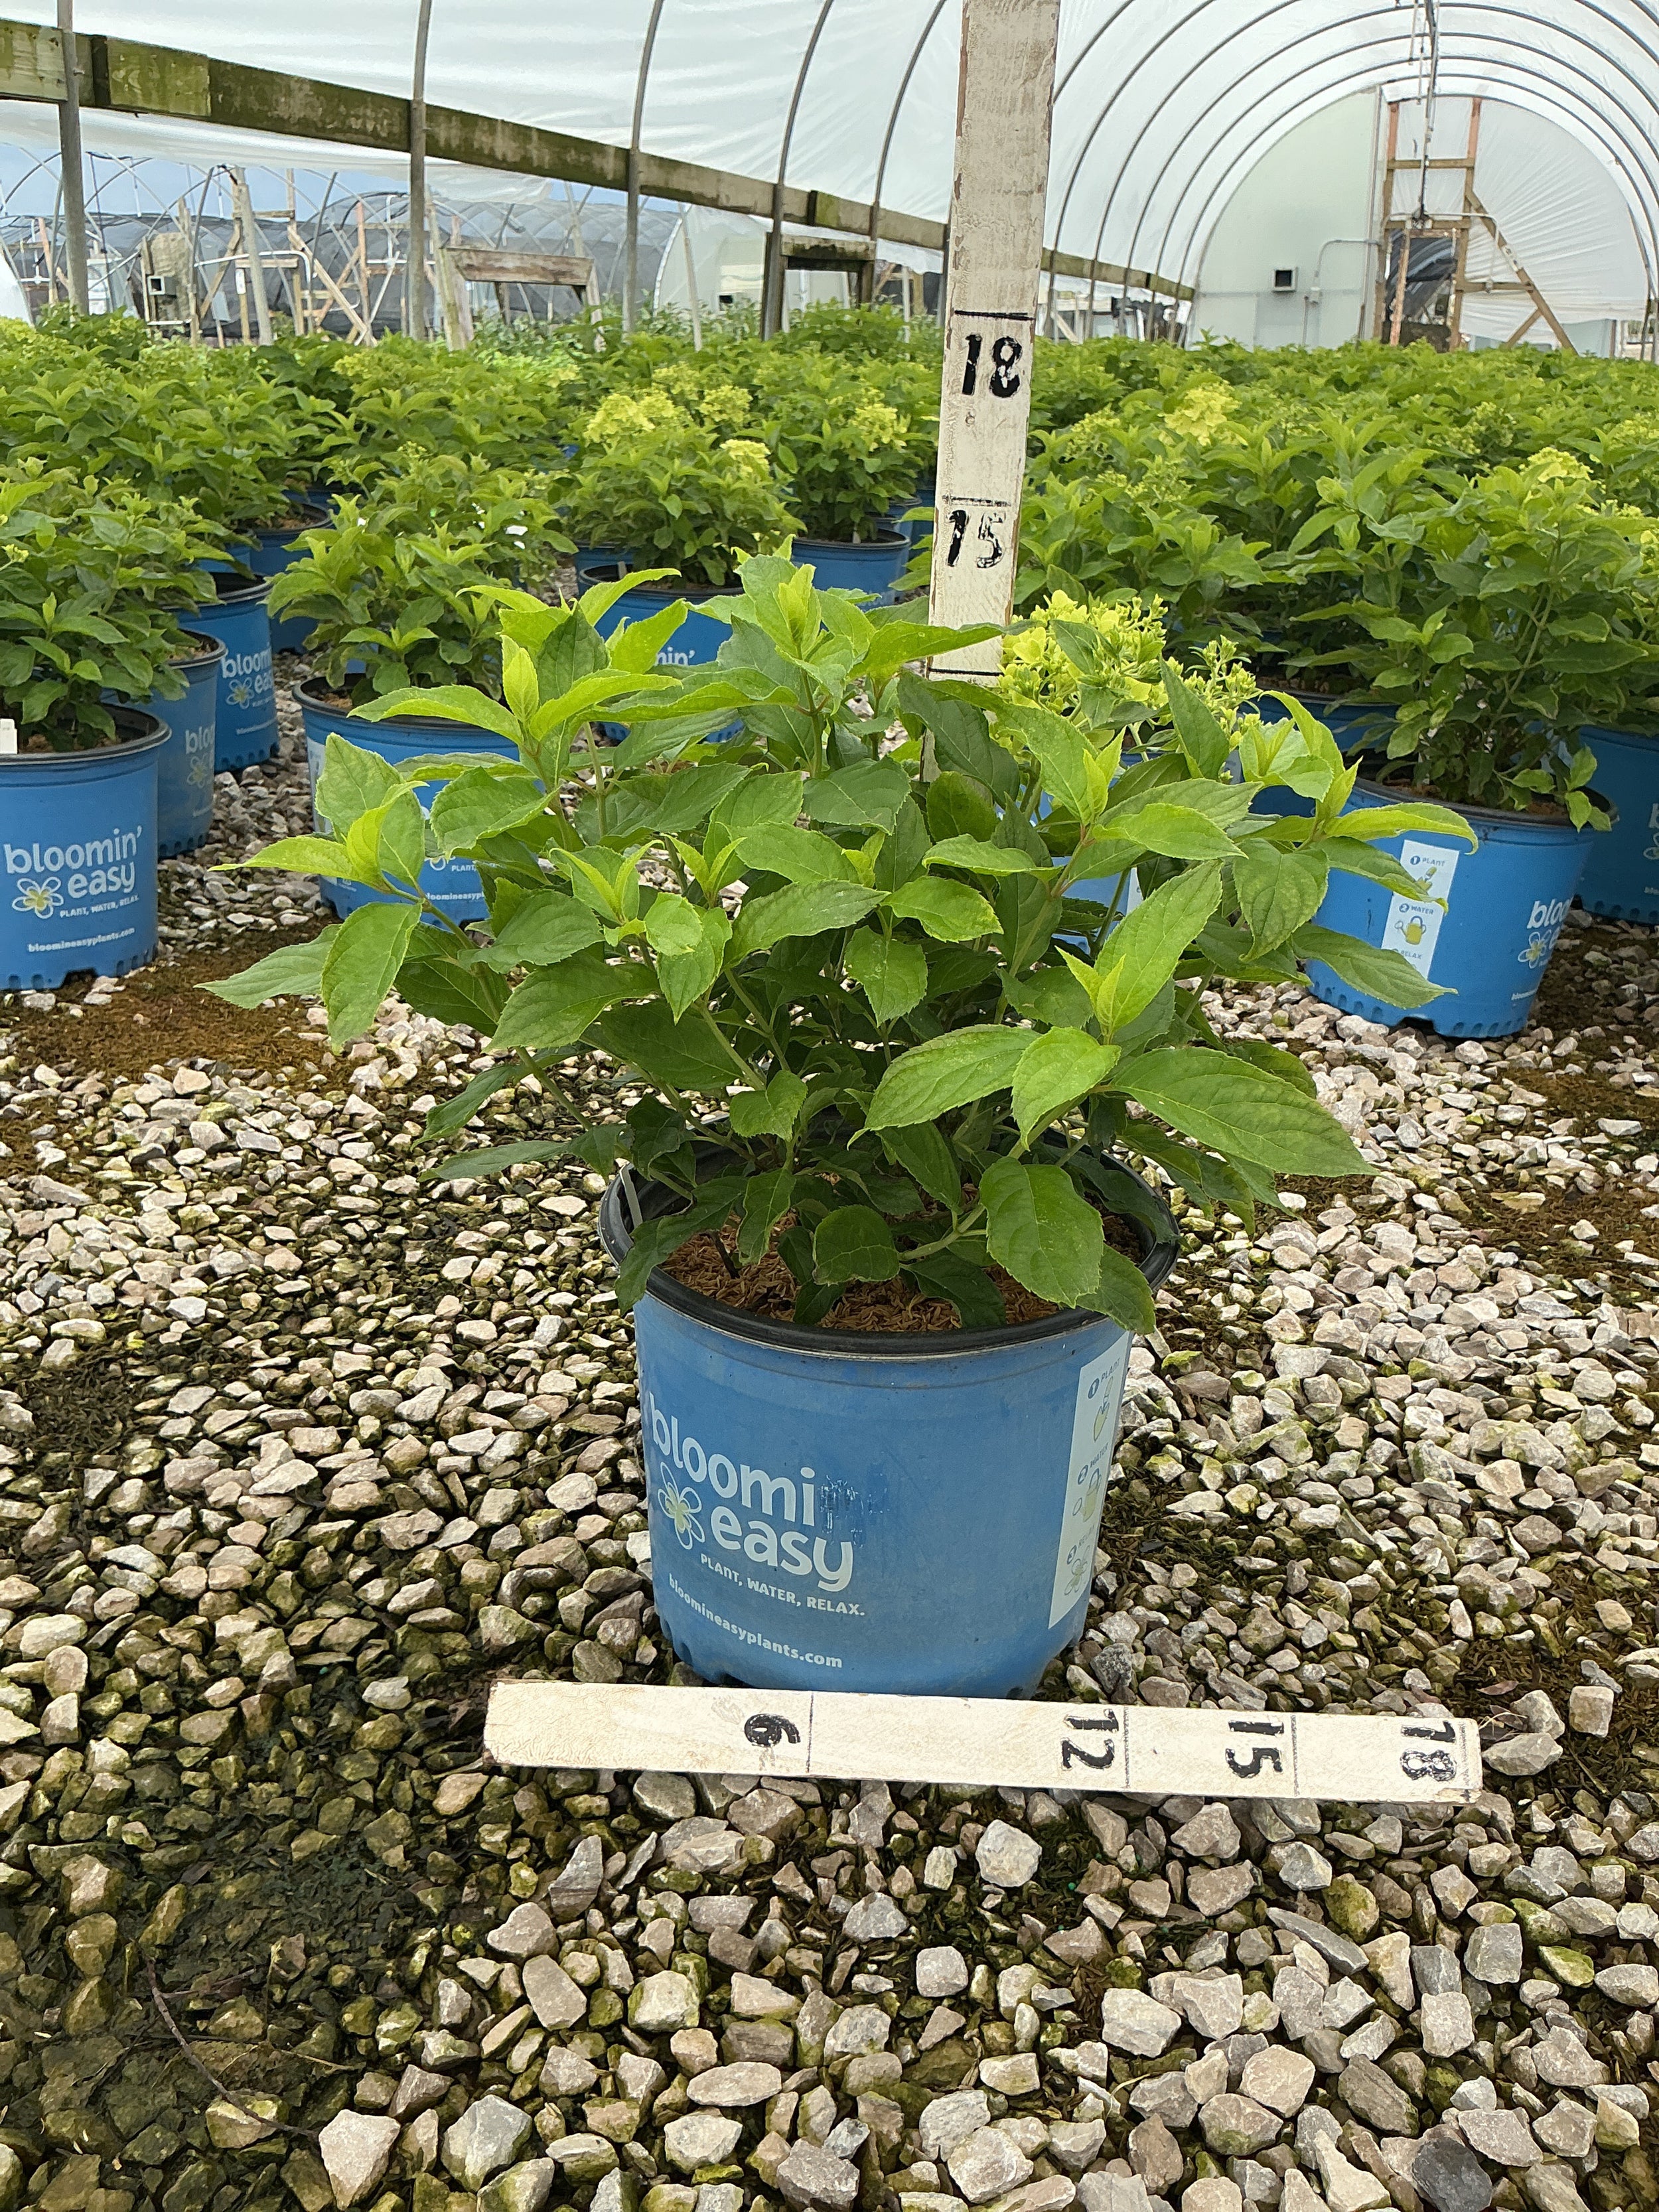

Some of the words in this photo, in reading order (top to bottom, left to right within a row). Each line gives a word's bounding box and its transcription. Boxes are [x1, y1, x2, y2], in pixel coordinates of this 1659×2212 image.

[962, 334, 1023, 398] 18
[946, 510, 1006, 568] 15
[3, 826, 142, 874] bloomin'
[1422, 857, 1445, 867] PLANT
[68, 861, 135, 899] easy
[1411, 905, 1434, 915] WATER
[1101, 1358, 1120, 1382] PLANT
[650, 1391, 863, 1529] bloomi
[711, 1506, 853, 1591] easy
[701, 1554, 743, 1586] PLANT,
[747, 1577, 801, 1606] WATER,
[807, 1596, 865, 1615] RELAX.
[669, 1573, 842, 1668] bloomineasyplants.com
[1061, 1708, 1119, 1770] 12
[1226, 1720, 1284, 1778] 15
[1400, 1720, 1457, 1781] 18
